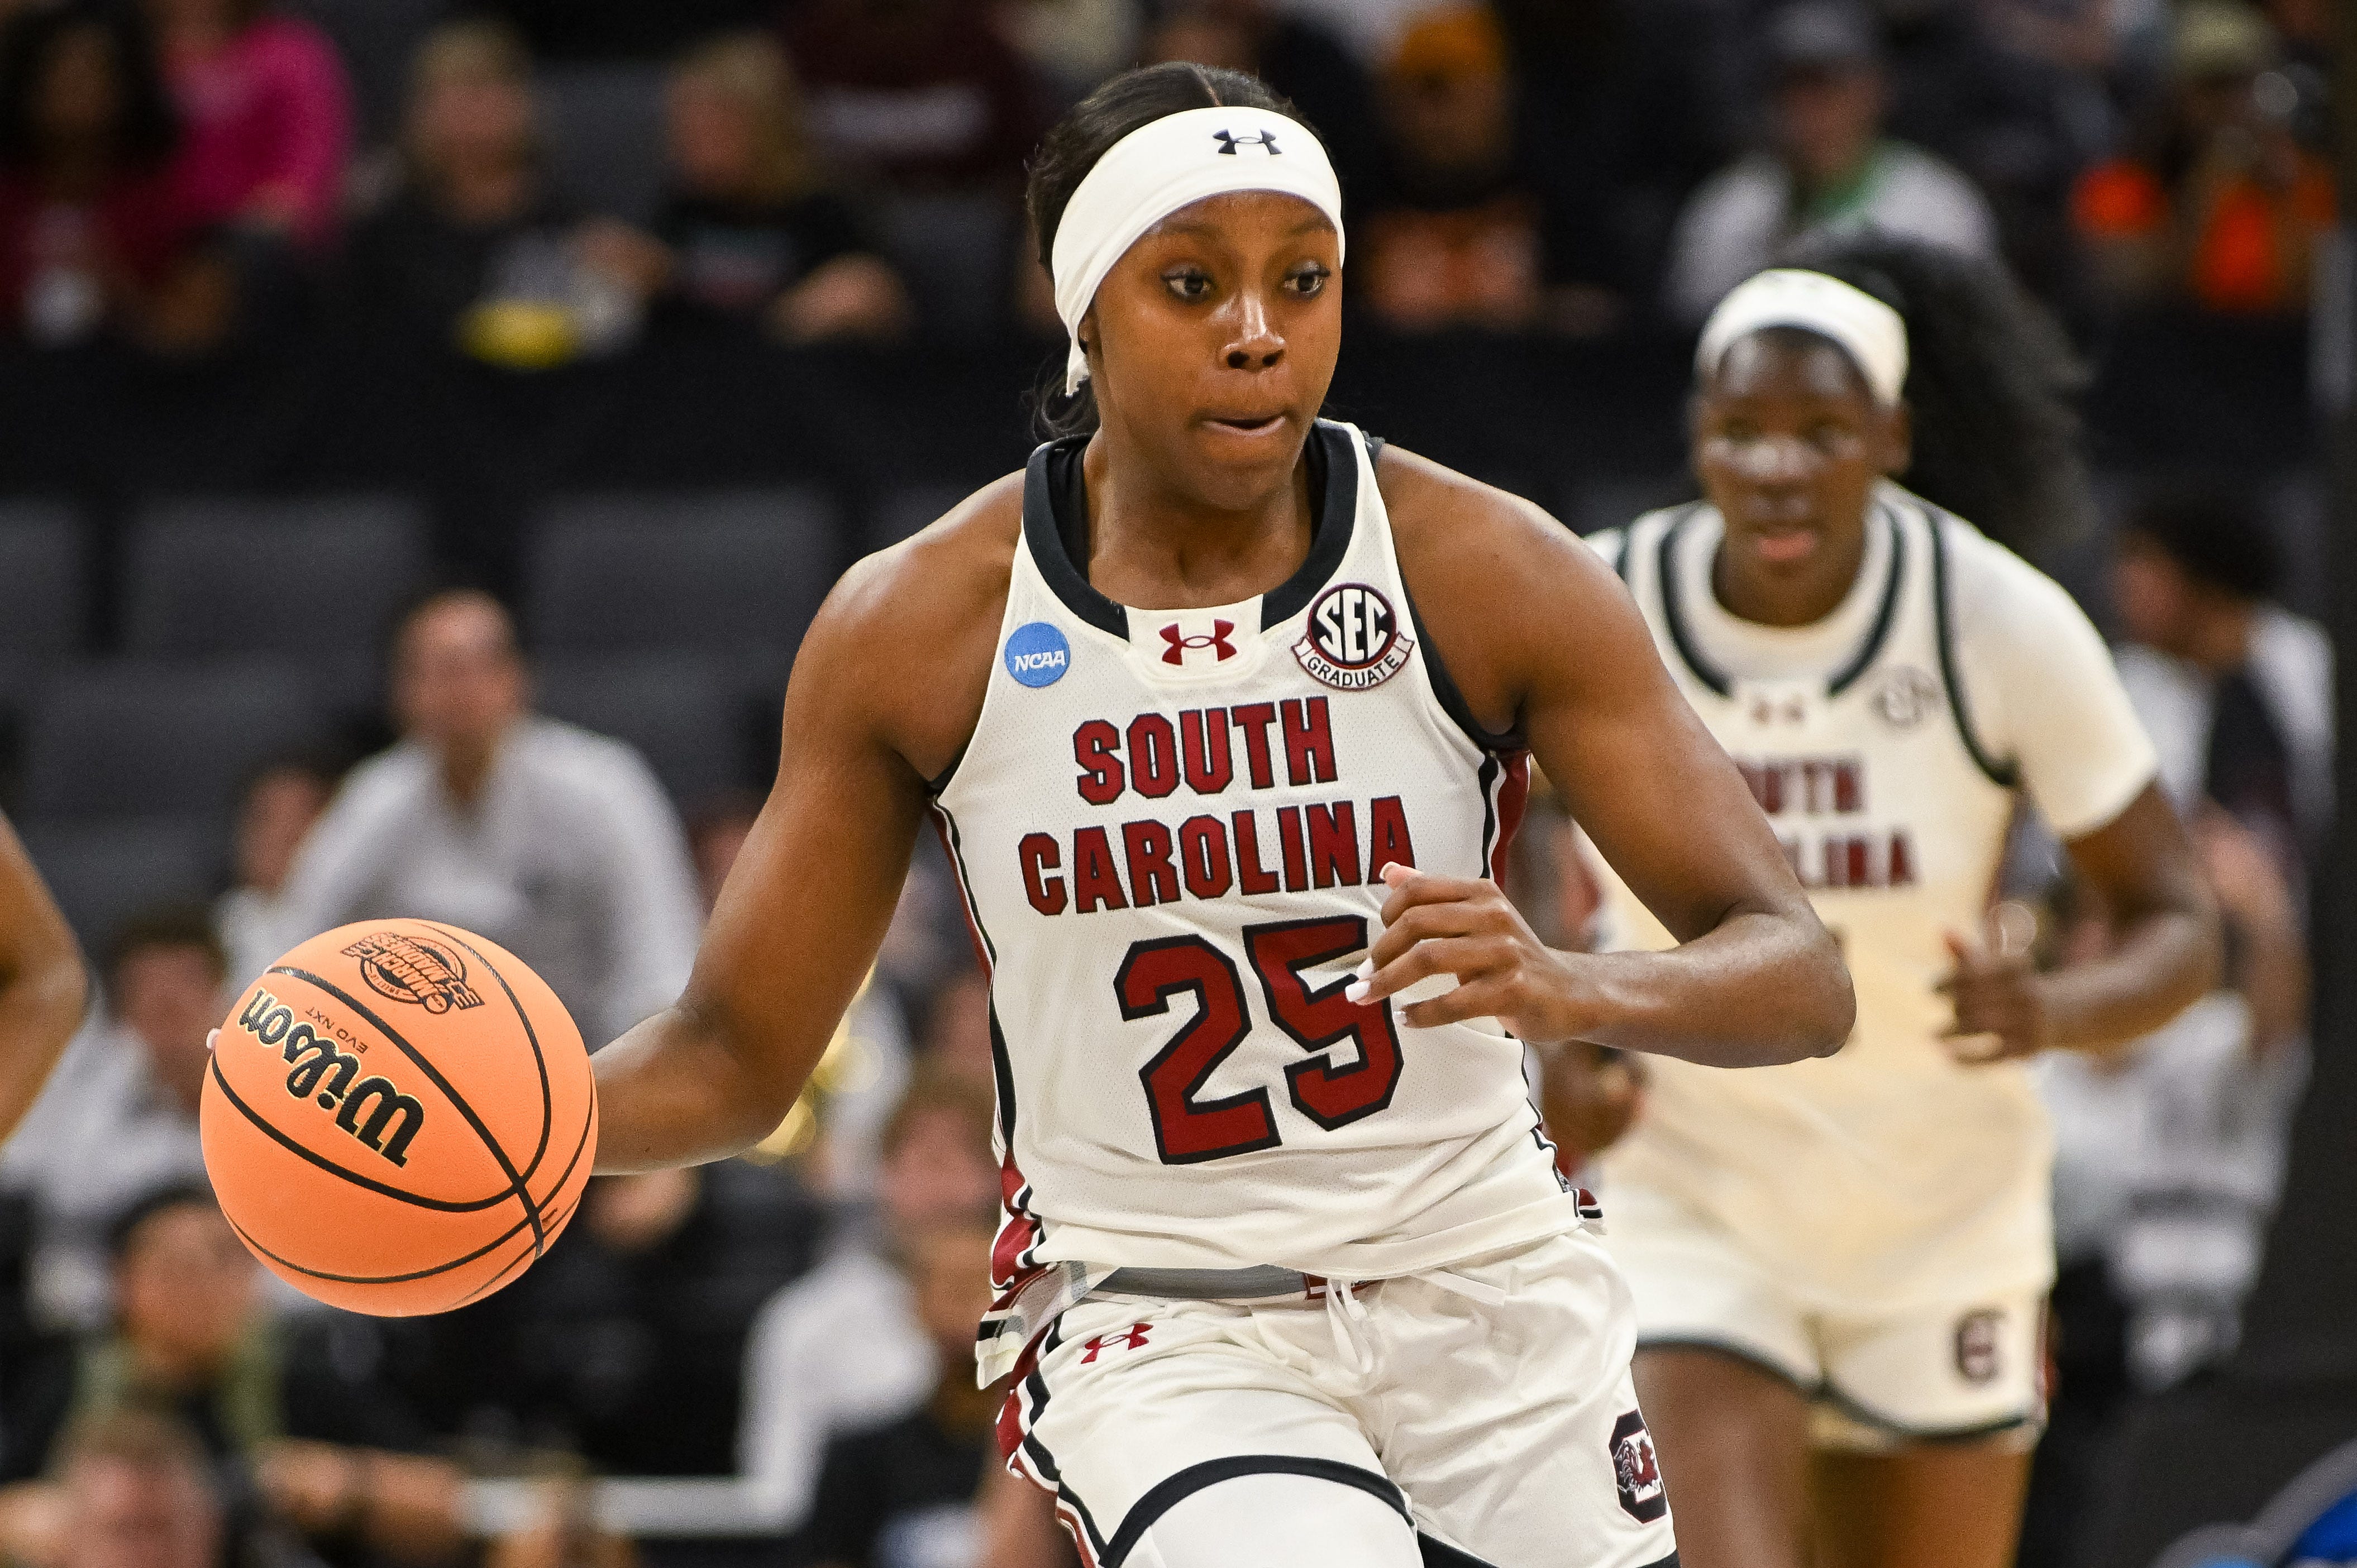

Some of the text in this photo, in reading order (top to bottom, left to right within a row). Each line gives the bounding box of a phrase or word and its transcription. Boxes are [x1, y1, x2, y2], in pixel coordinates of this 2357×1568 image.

[1014, 649, 1066, 672] NCAA
[1316, 588, 1389, 662] SEC
[1307, 654, 1400, 687] GRADUATE
[1072, 695, 1339, 806] SOUTH
[1018, 795, 1417, 916] CAROLINA
[370, 951, 440, 998] MARCH
[305, 1006, 369, 1054] EVO NXT
[1113, 914, 1405, 1165] 25
[237, 987, 424, 1168] Wilson
